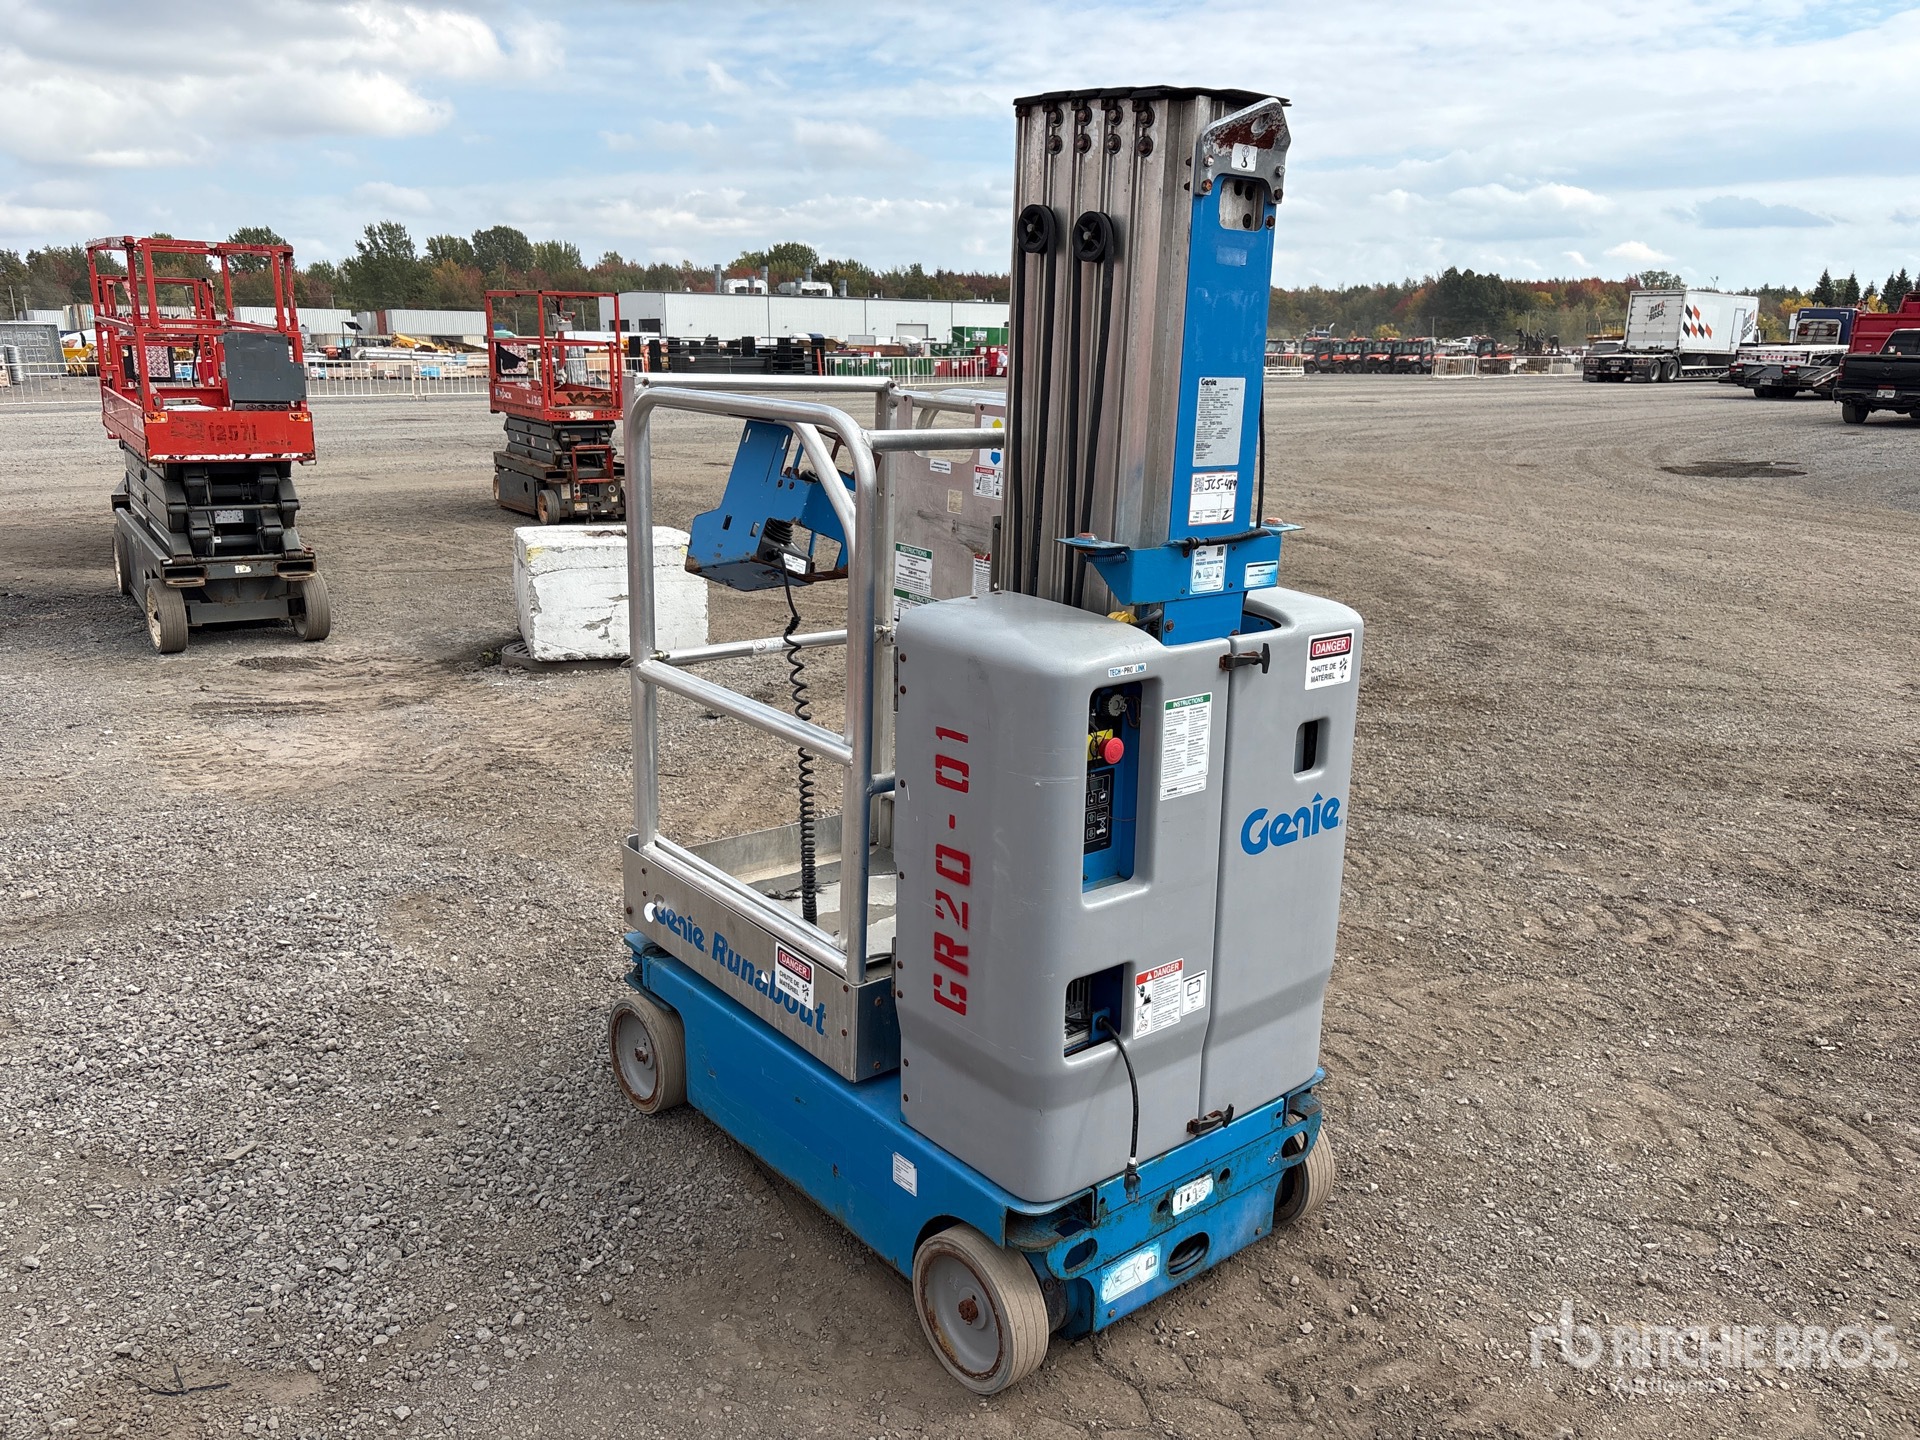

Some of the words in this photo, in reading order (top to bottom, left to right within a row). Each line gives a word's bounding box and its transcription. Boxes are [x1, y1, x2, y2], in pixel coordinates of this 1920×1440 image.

[1650, 303, 1660, 313] DAY
[1649, 310, 1664, 322] ROSS
[1200, 378, 1217, 386] Genie
[900, 545, 928, 557] INSTRUCTIONS
[1315, 638, 1347, 654] DANGER
[1310, 663, 1328, 674] CHUTE
[1328, 662, 1337, 670] DE
[1310, 672, 1336, 684] MATÉRIEL
[1172, 696, 1204, 708] INSTRUCTIONS
[1240, 792, 1341, 856] Genie
[781, 954, 808, 977] DANGER
[1153, 961, 1180, 979] DANGER
[711, 932, 827, 1035] Runabout
[779, 970, 794, 984] CHUTE
[793, 979, 800, 989] DE
[778, 979, 800, 996] MATÉRIEL
